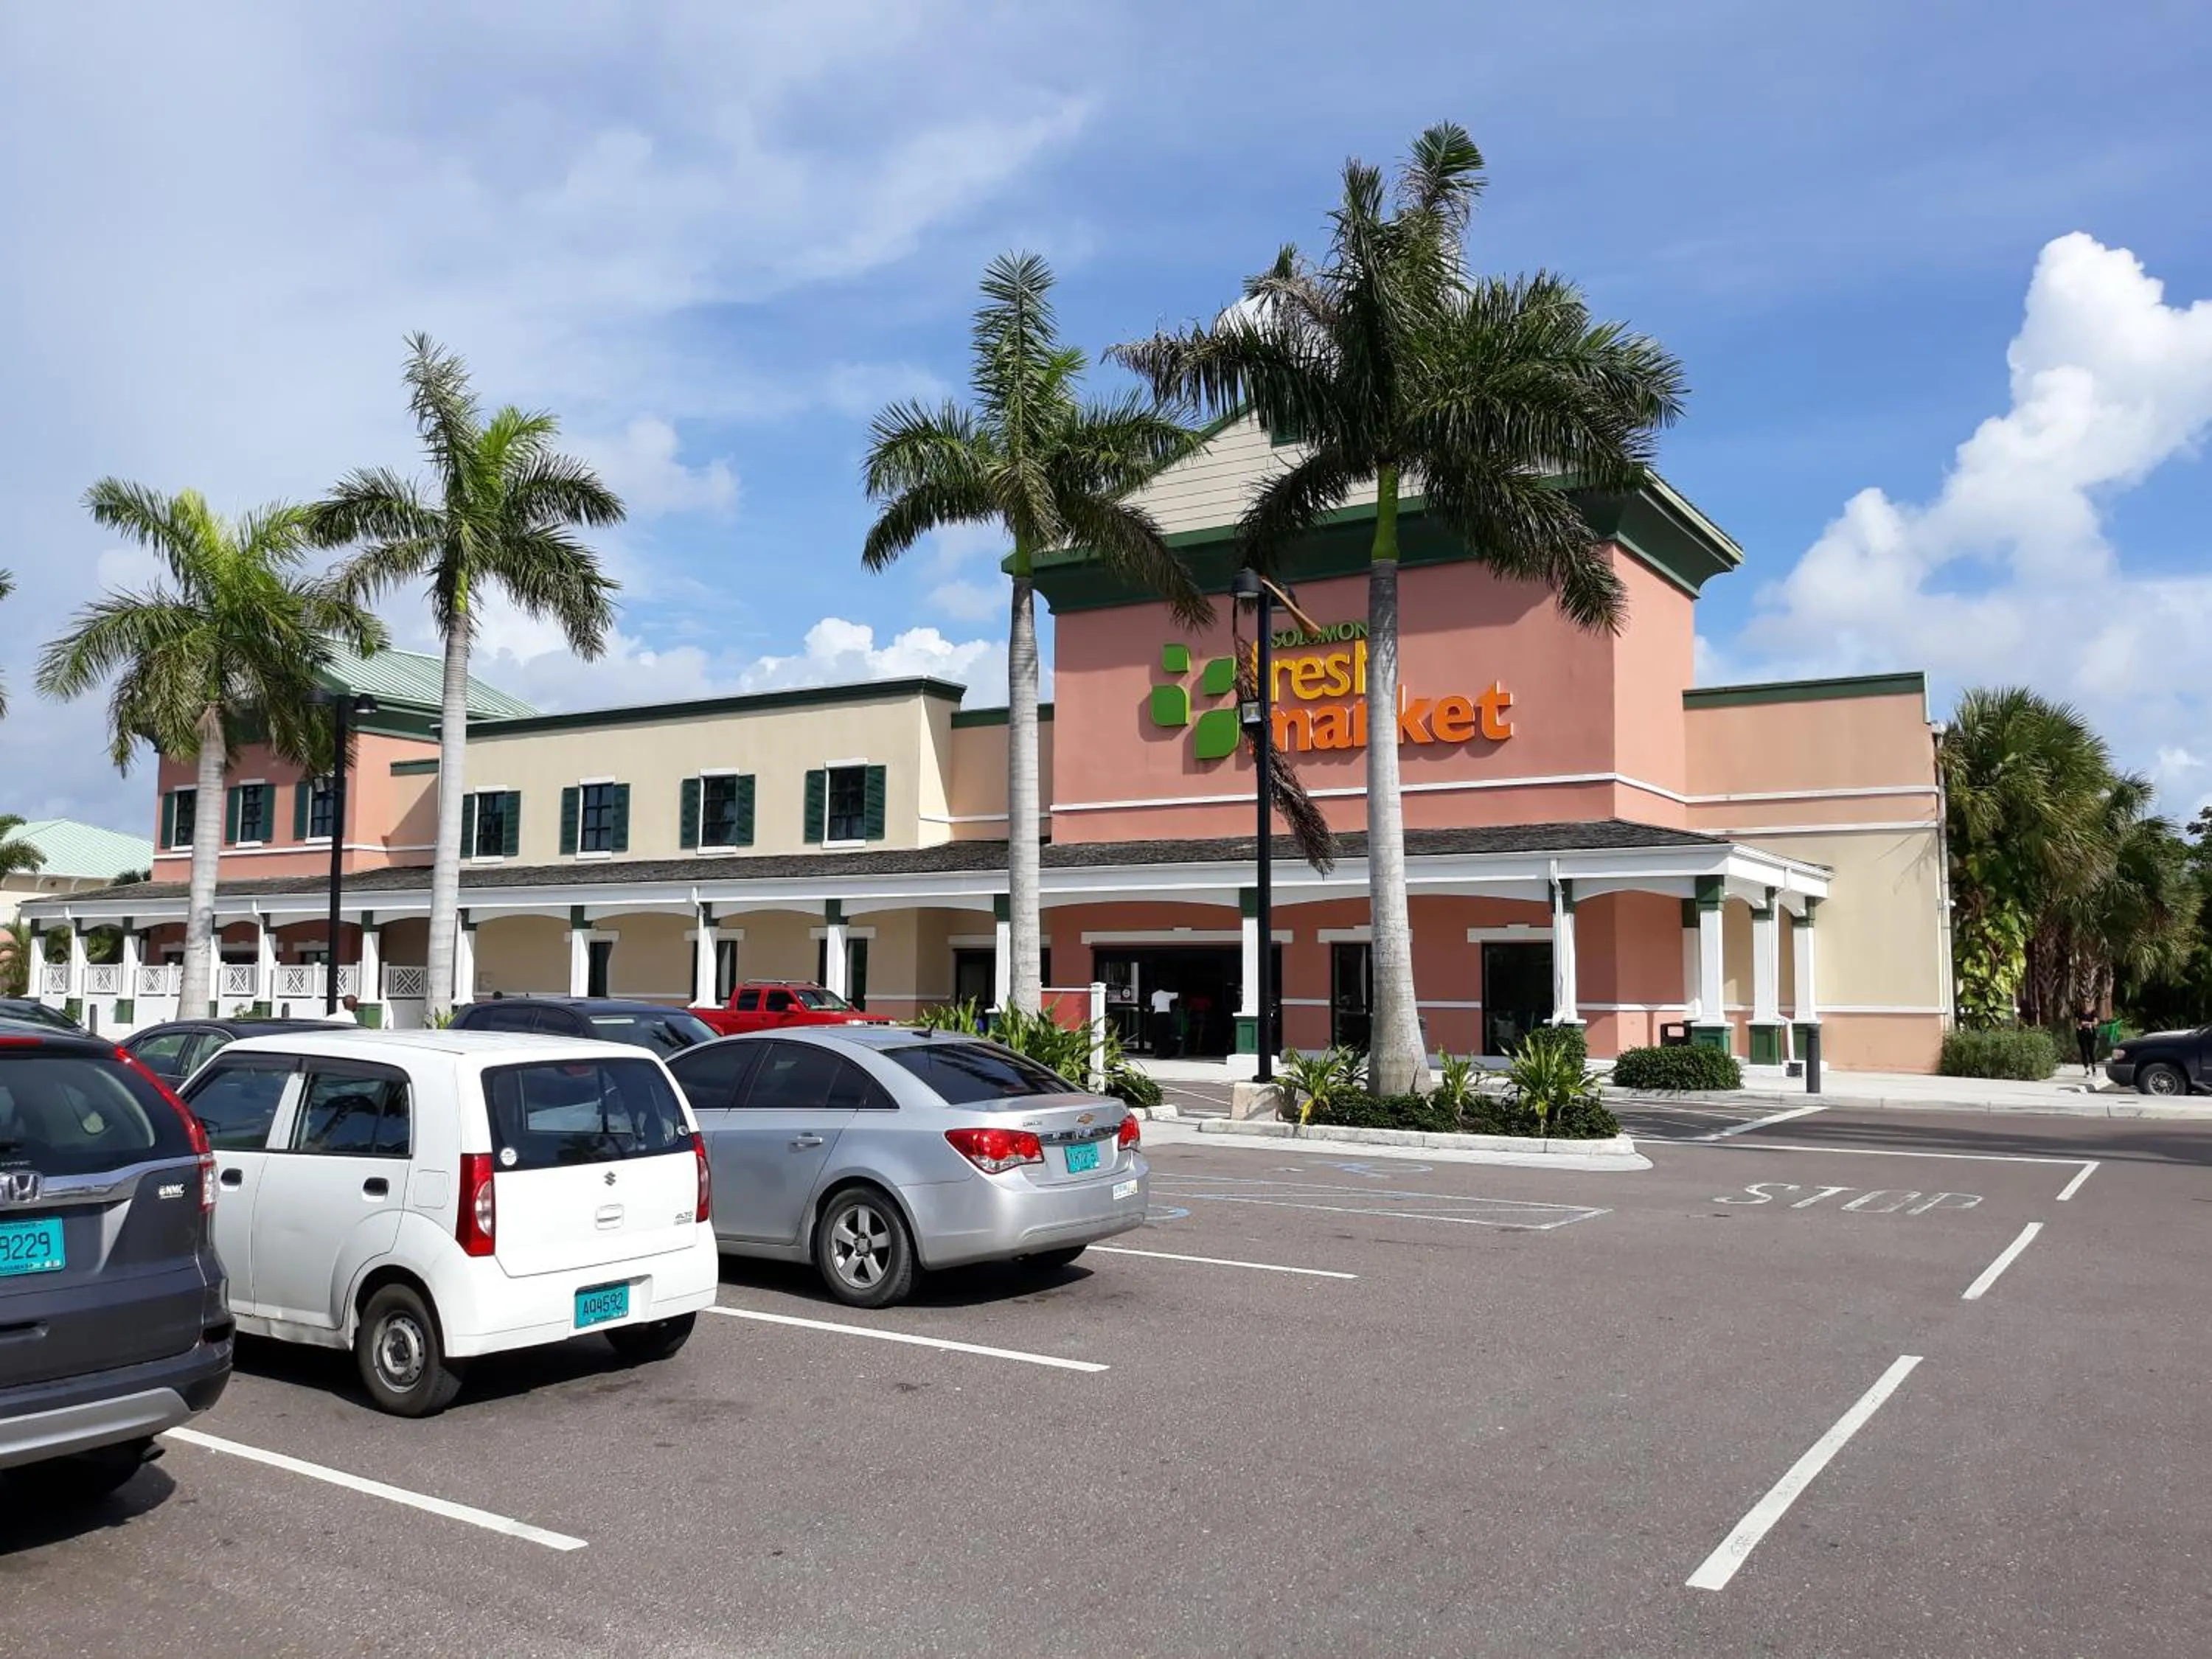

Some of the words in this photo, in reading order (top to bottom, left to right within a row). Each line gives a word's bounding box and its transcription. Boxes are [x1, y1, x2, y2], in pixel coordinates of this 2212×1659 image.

[1251, 639, 1368, 703] res
[1712, 1182, 1984, 1215] STOP
[0, 1232, 51, 1262] 9229
